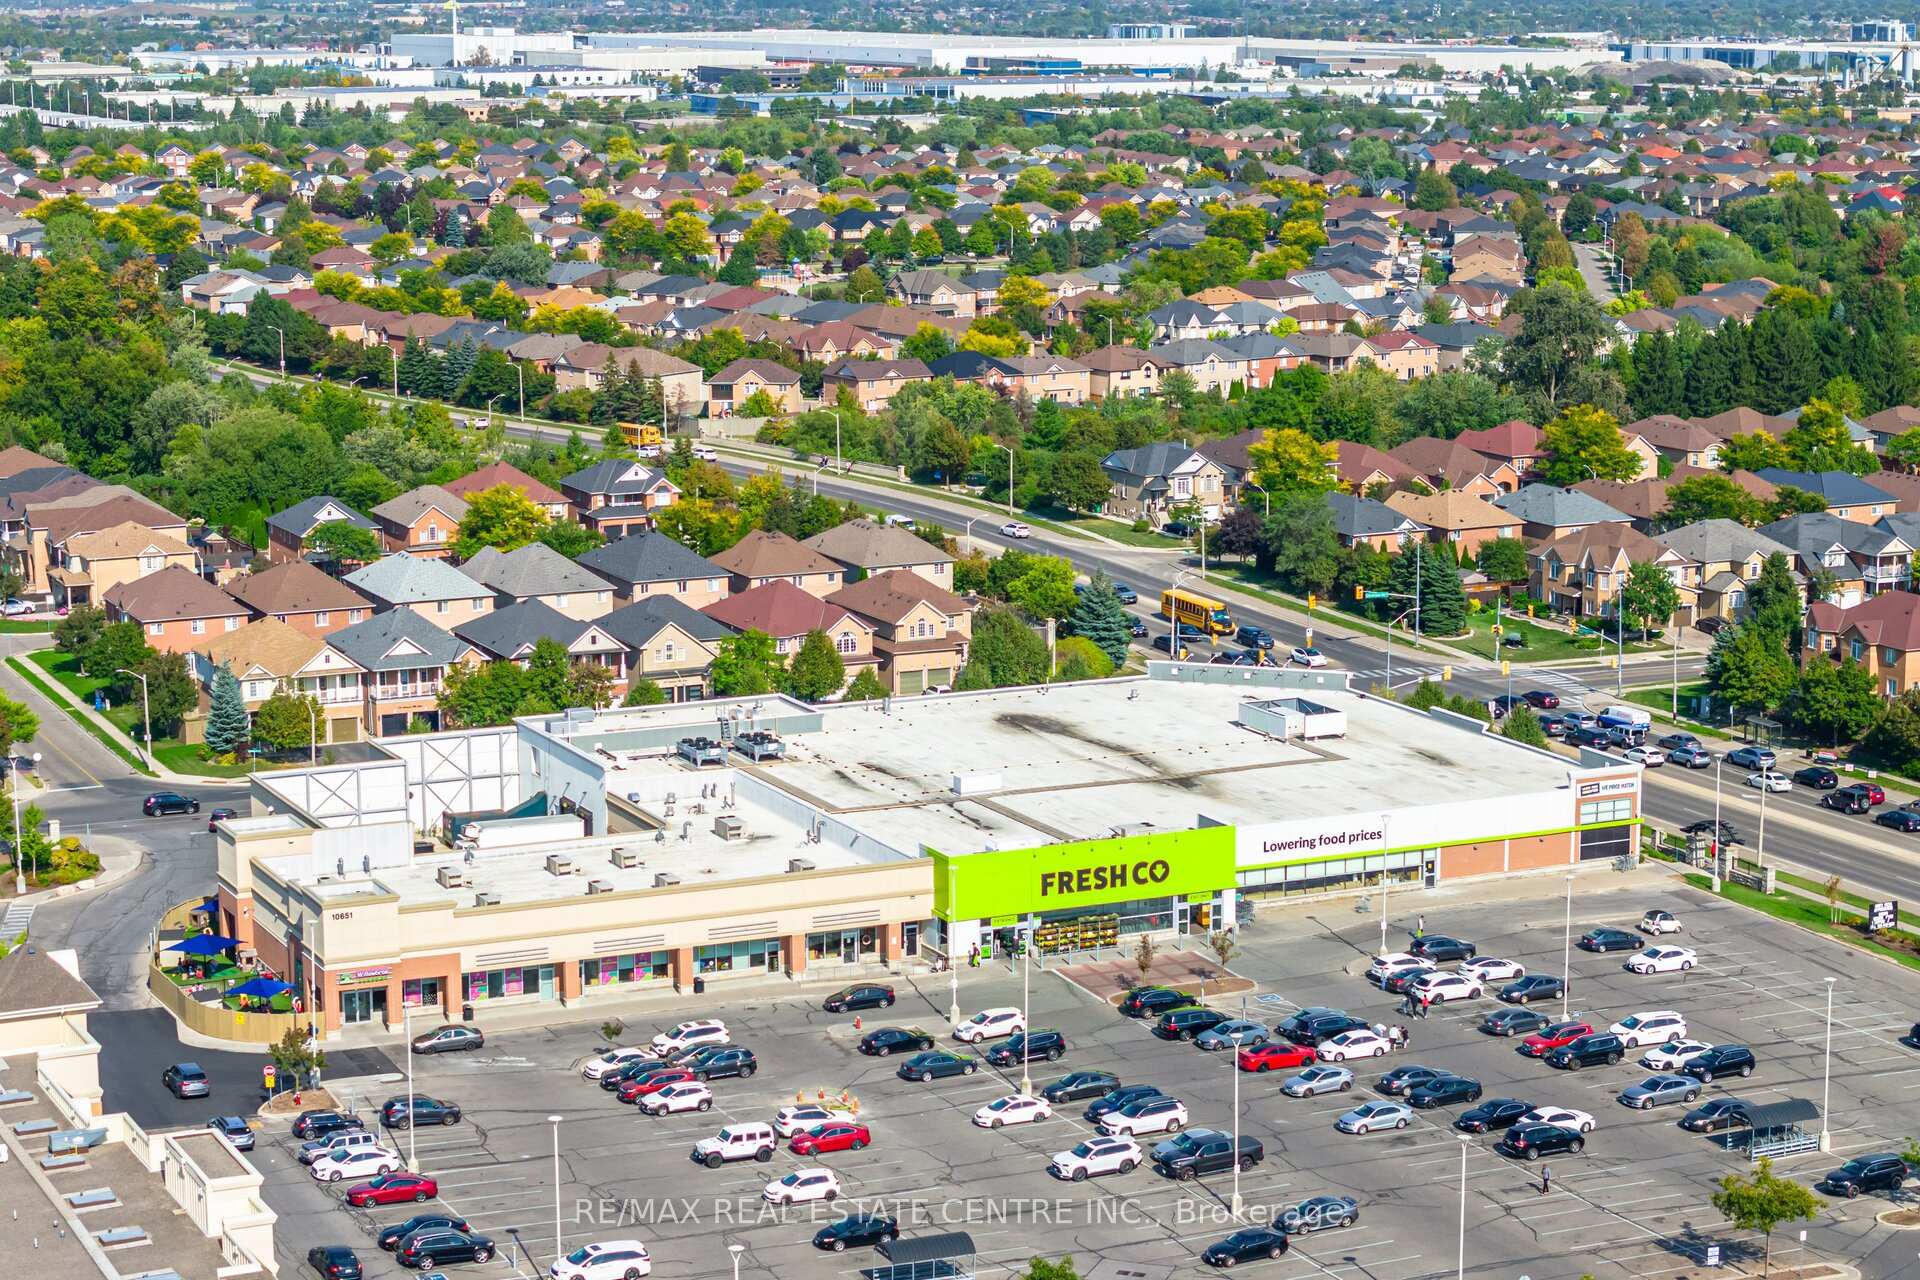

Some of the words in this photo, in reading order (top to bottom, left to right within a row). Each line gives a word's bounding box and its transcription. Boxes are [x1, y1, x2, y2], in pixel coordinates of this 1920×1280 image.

[1263, 836, 1317, 853] Lowering
[1318, 832, 1346, 847] food
[1348, 829, 1383, 845] prices
[1041, 864, 1127, 896] FRESH
[1132, 859, 1170, 886] CO
[332, 912, 353, 920] 10651
